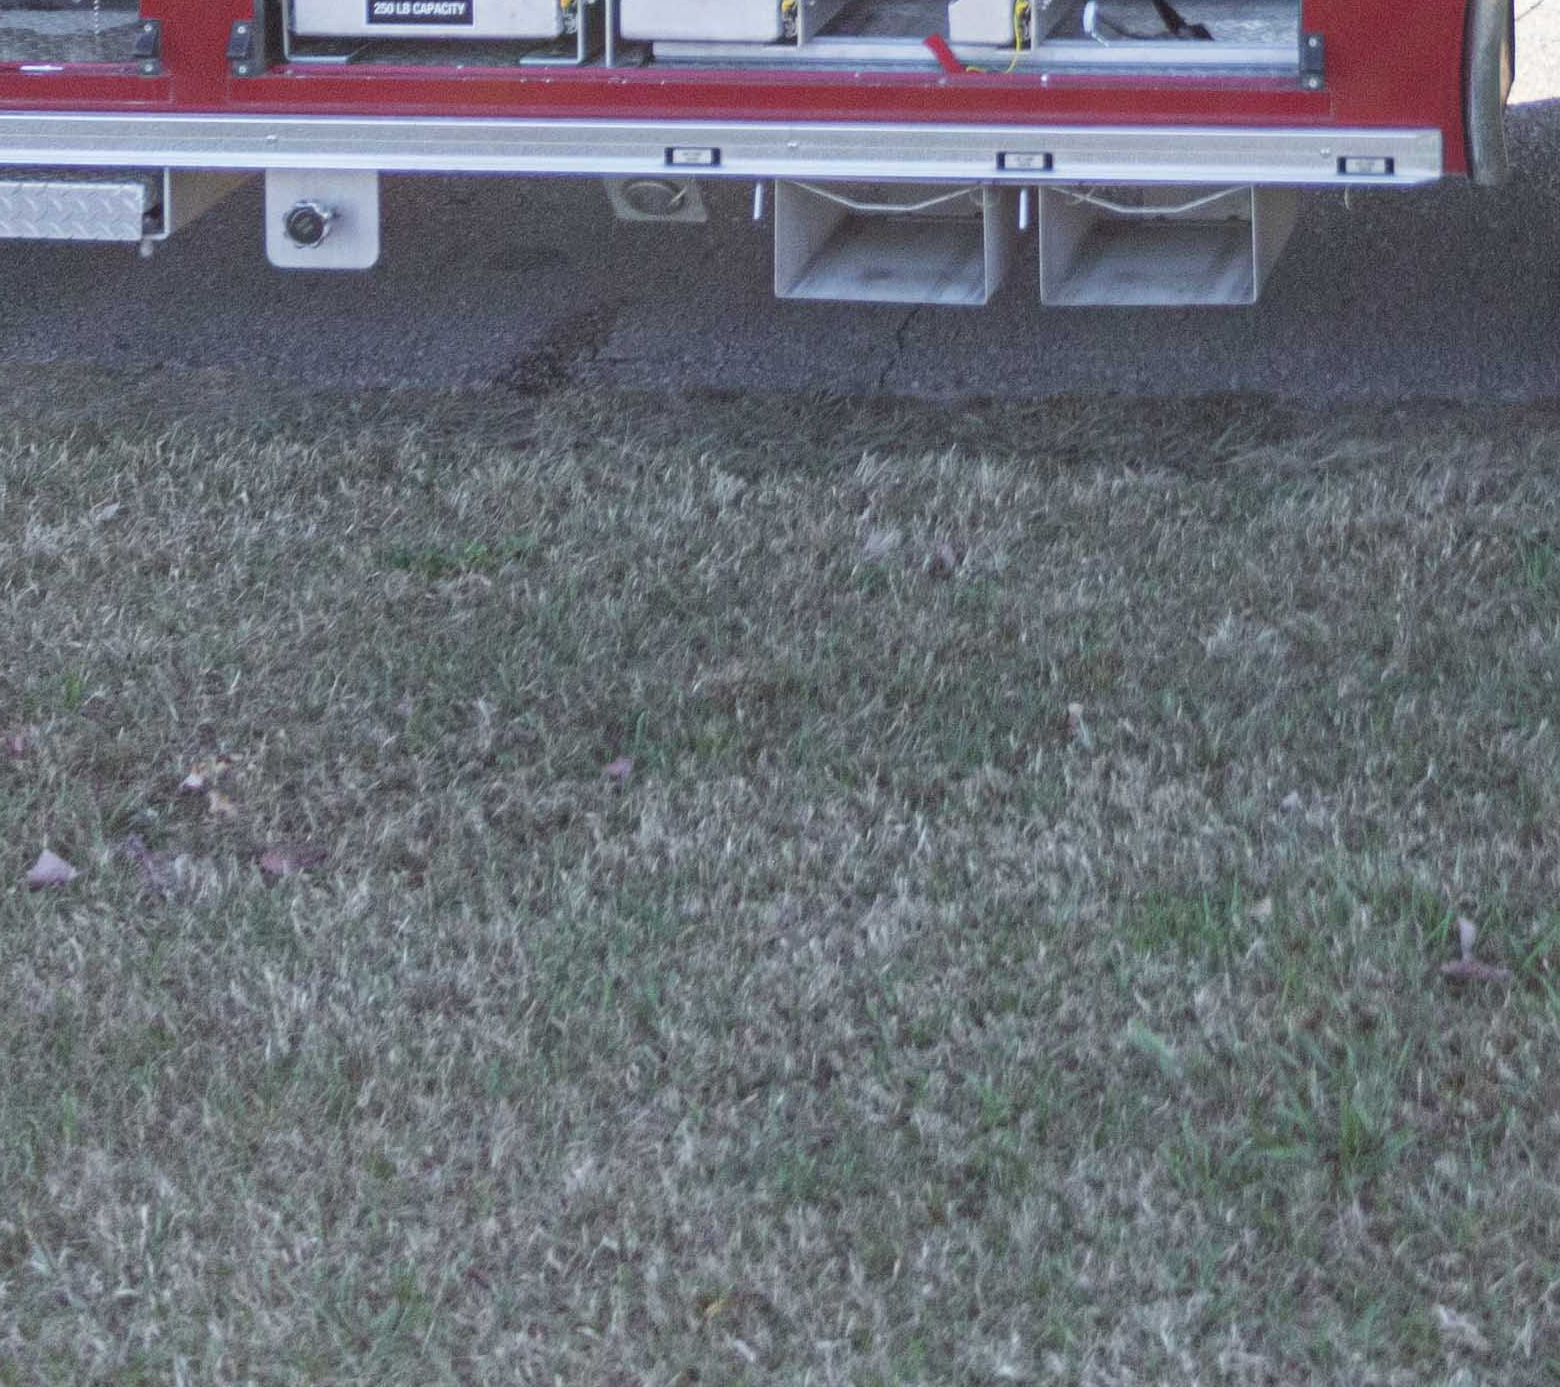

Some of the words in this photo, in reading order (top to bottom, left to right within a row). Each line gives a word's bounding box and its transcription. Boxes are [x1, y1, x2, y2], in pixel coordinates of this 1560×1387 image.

[373, 1, 394, 15] 250
[396, 1, 410, 15] LB
[412, 1, 466, 15] CAPACITY
